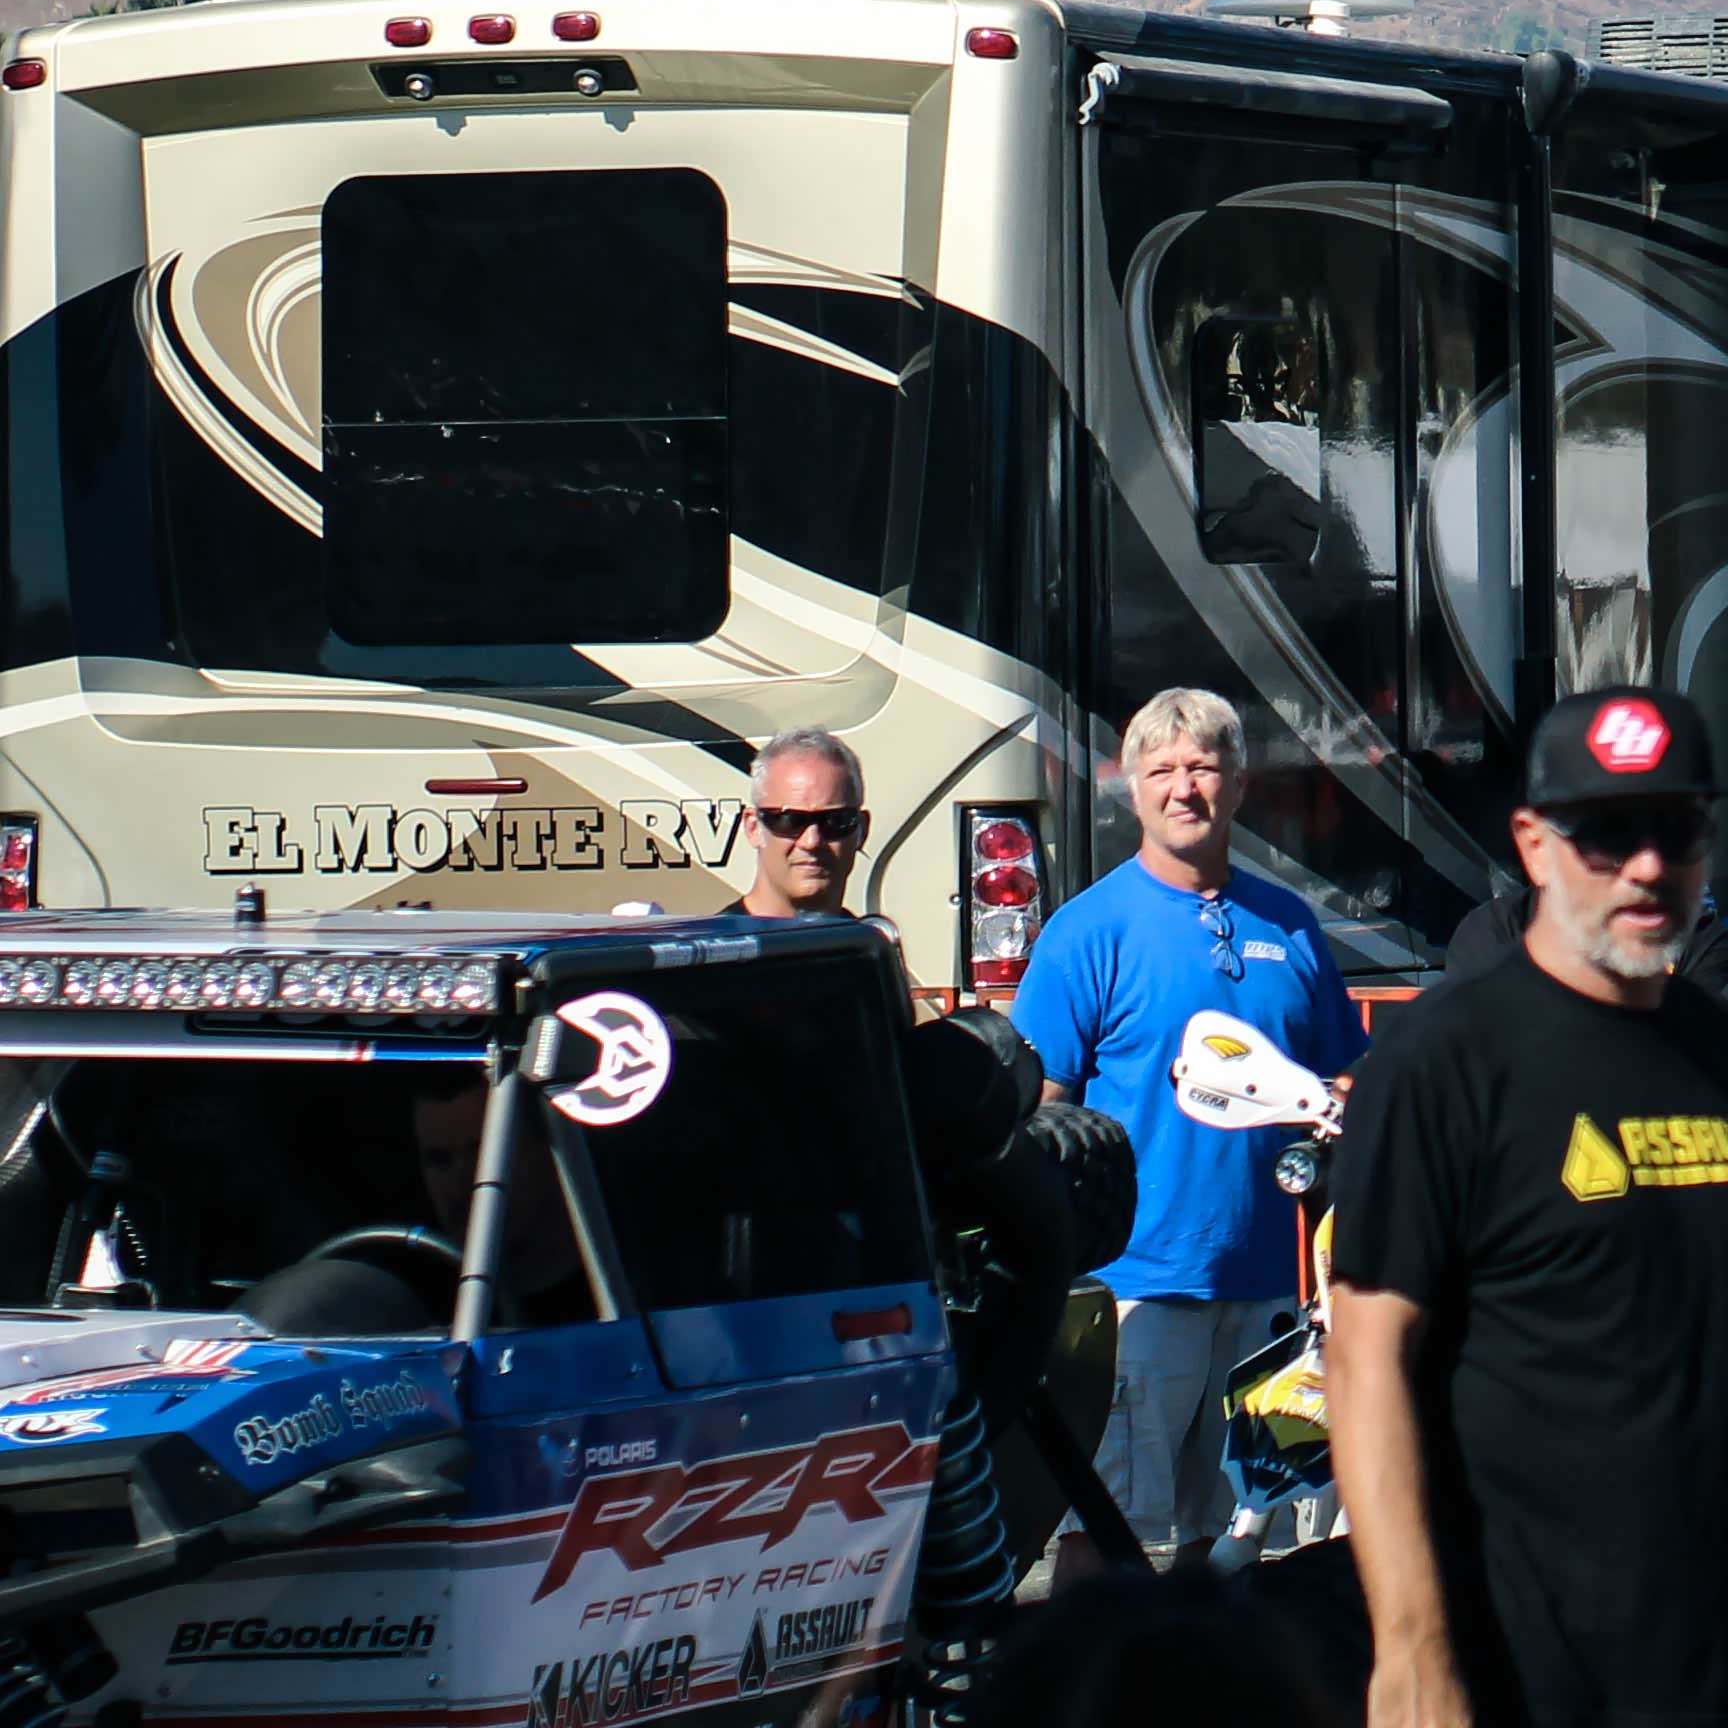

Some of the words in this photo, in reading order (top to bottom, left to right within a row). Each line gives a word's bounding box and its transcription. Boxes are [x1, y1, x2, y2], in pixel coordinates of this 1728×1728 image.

[620, 799, 745, 871] RV
[233, 1393, 344, 1467] Bomb
[340, 1370, 431, 1431] Squad
[584, 1439, 657, 1469] POLARIS
[531, 1419, 913, 1606] RZR
[579, 1572, 747, 1631] FACTORY
[752, 1548, 892, 1595] RACING
[168, 1614, 437, 1655] BFGoodrich
[776, 1597, 876, 1661] ASSAULT
[563, 1633, 697, 1726] KICKER
